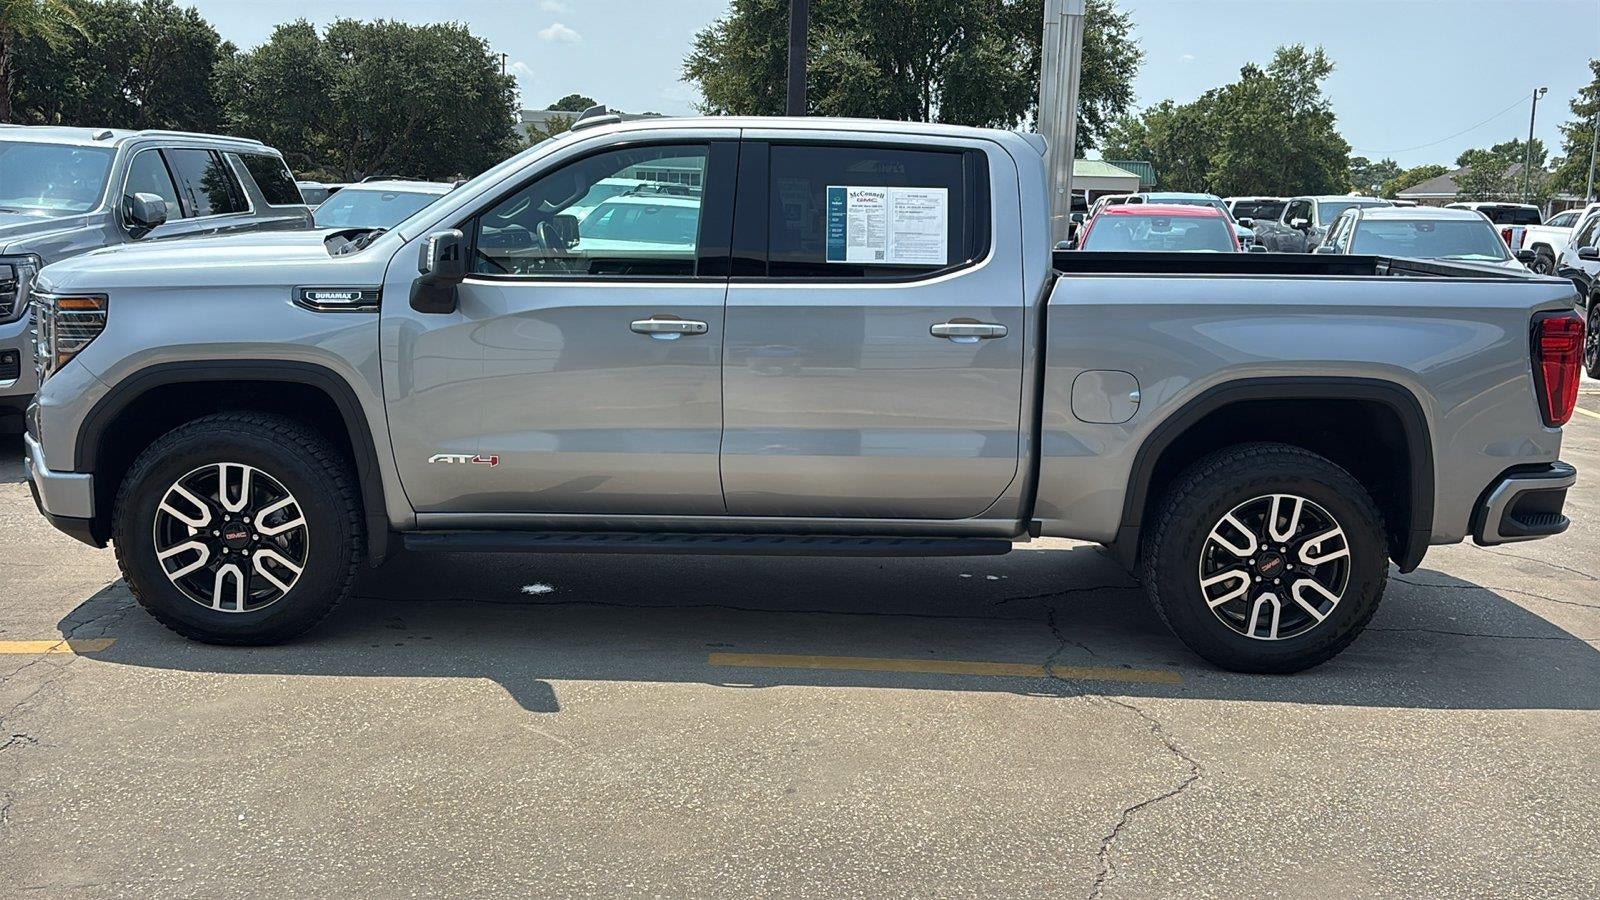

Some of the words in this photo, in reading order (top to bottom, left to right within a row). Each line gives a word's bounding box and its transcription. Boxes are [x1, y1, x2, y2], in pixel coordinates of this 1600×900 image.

[849, 191, 885, 199] McConnell
[428, 454, 499, 468] AT4
[226, 531, 247, 540] GMC
